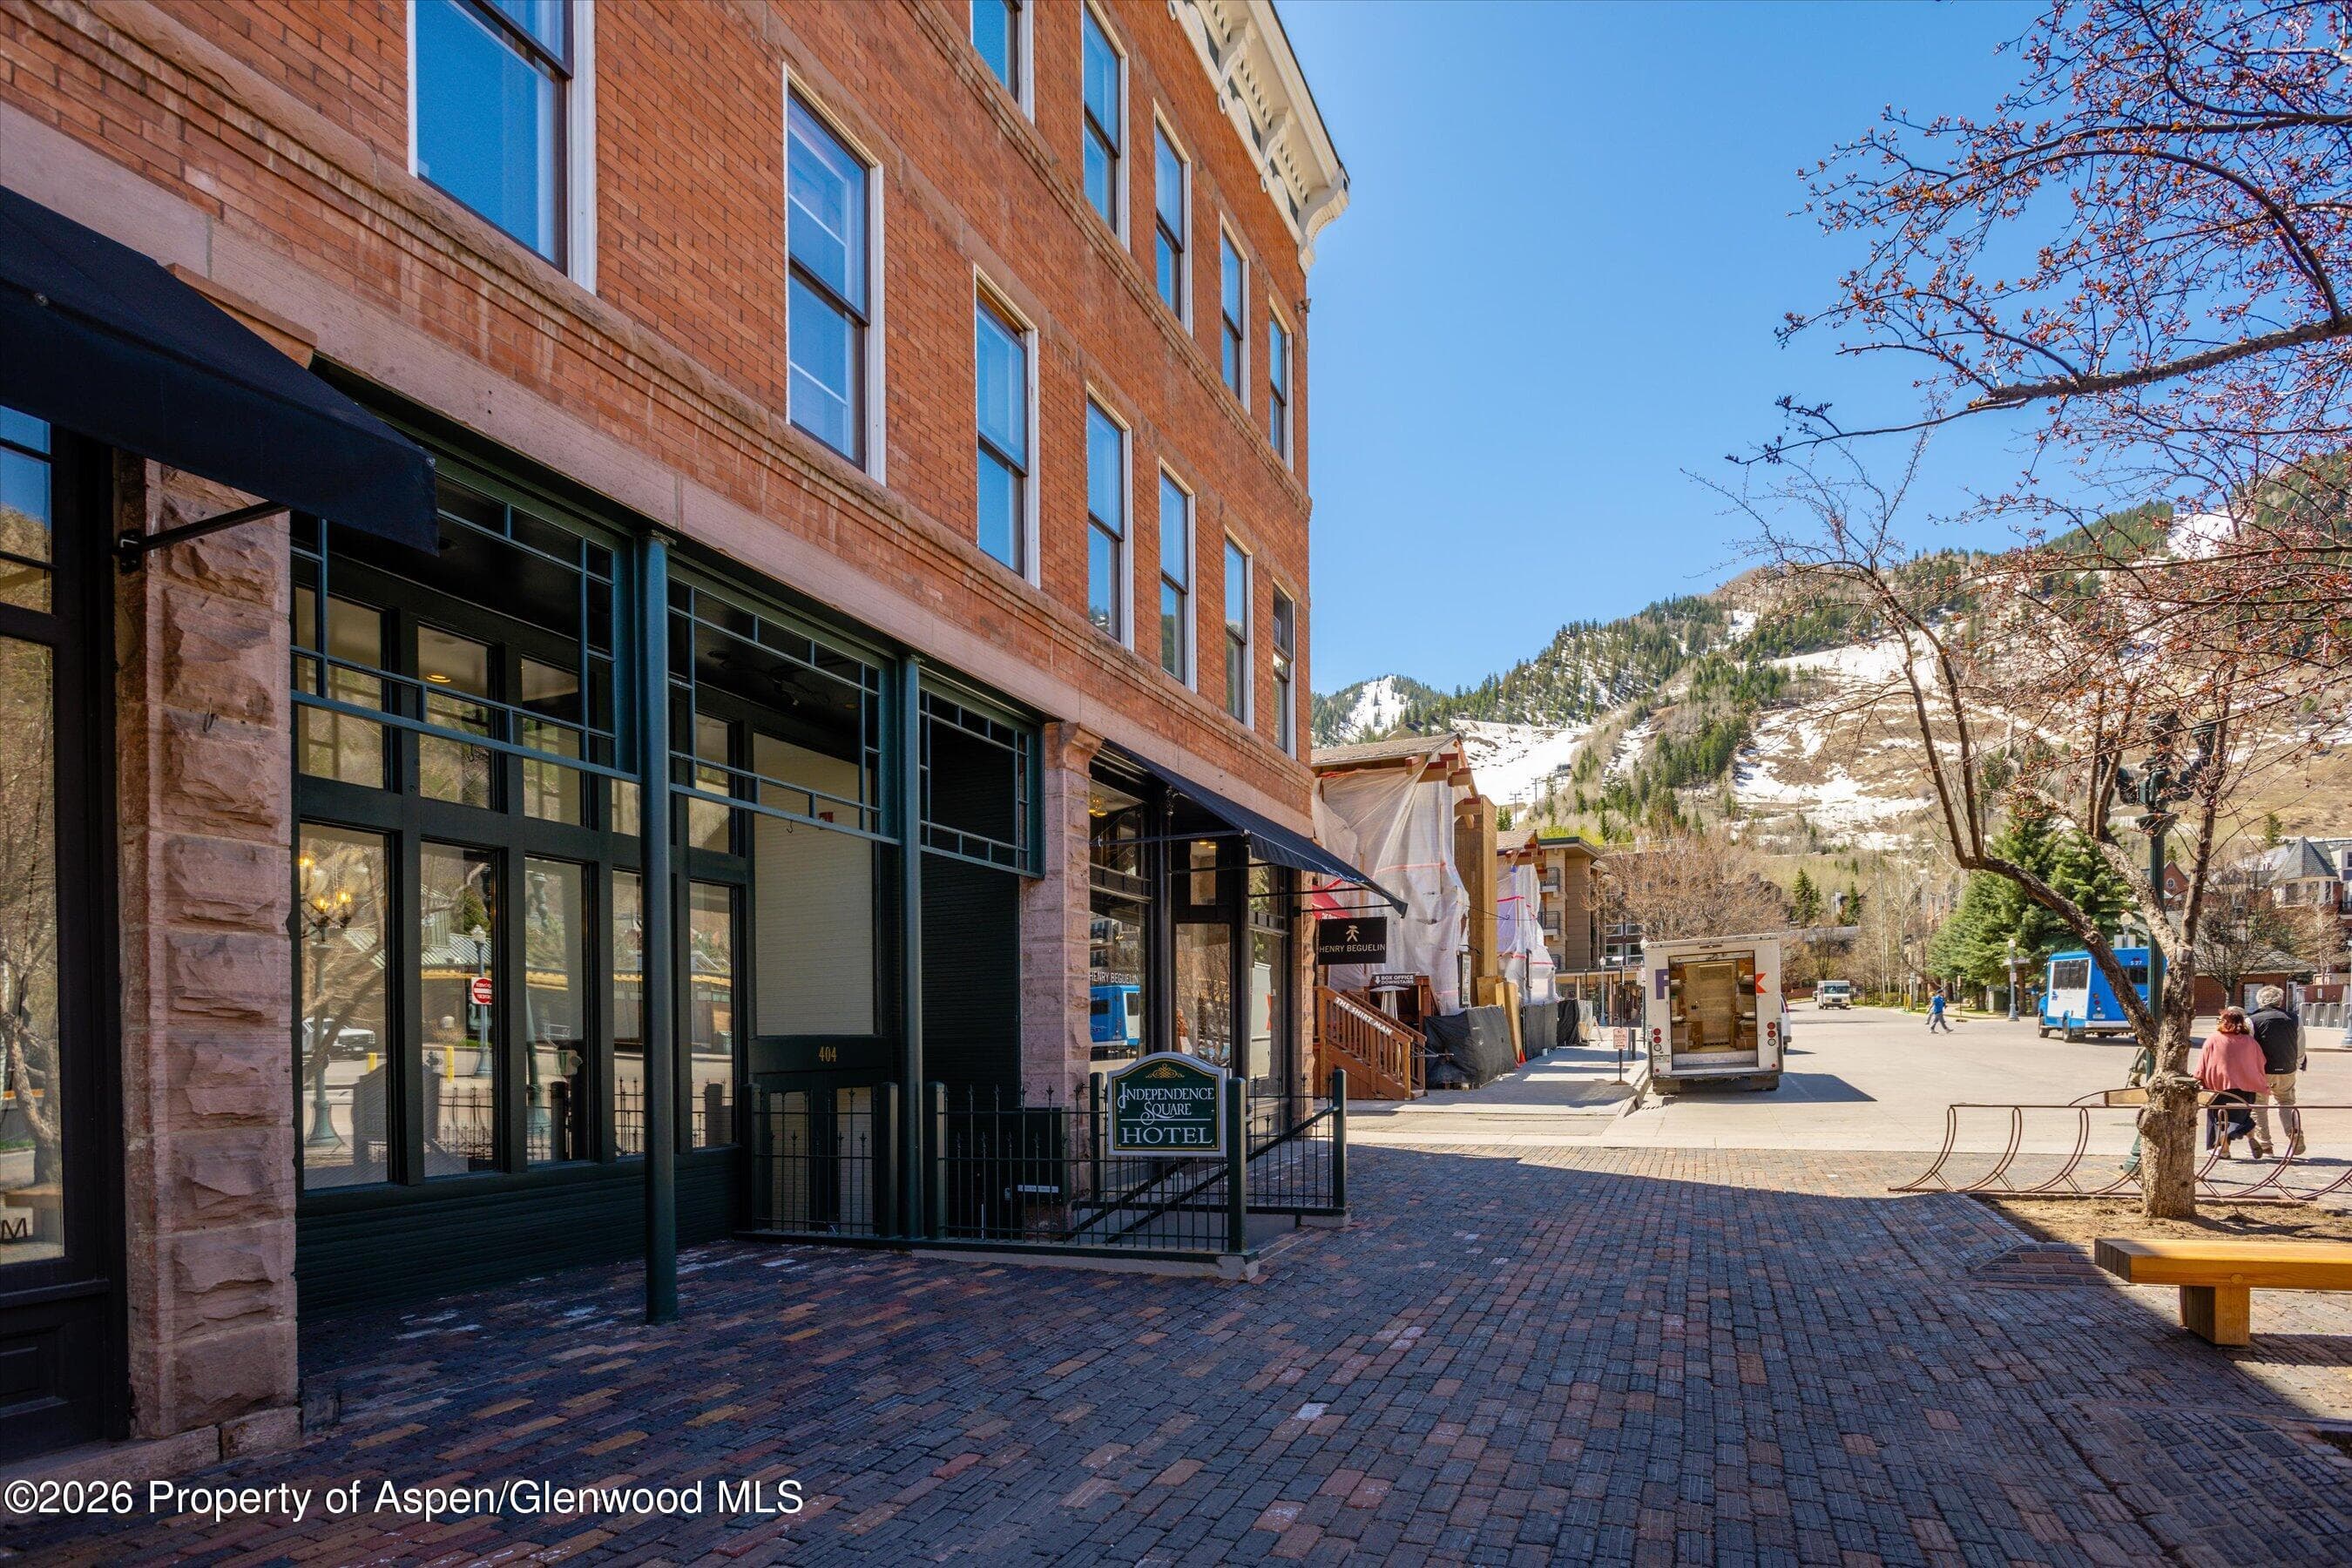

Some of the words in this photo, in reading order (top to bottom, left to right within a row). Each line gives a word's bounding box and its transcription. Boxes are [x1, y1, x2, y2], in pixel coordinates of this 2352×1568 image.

[1347, 943, 1386, 952] BEGUELIN
[1090, 970, 1110, 983] HENRY
[1111, 972, 1139, 984] BEGUELIN
[1335, 997, 1351, 1010] THE
[1351, 1007, 1373, 1023] SHIRT
[1374, 1021, 1393, 1036] MAN
[819, 1046, 836, 1062] 404
[1118, 1083, 1214, 1109] INDEPENDENCE
[1140, 1100, 1192, 1125] SQUARE
[1121, 1127, 1213, 1144] HOTEL
